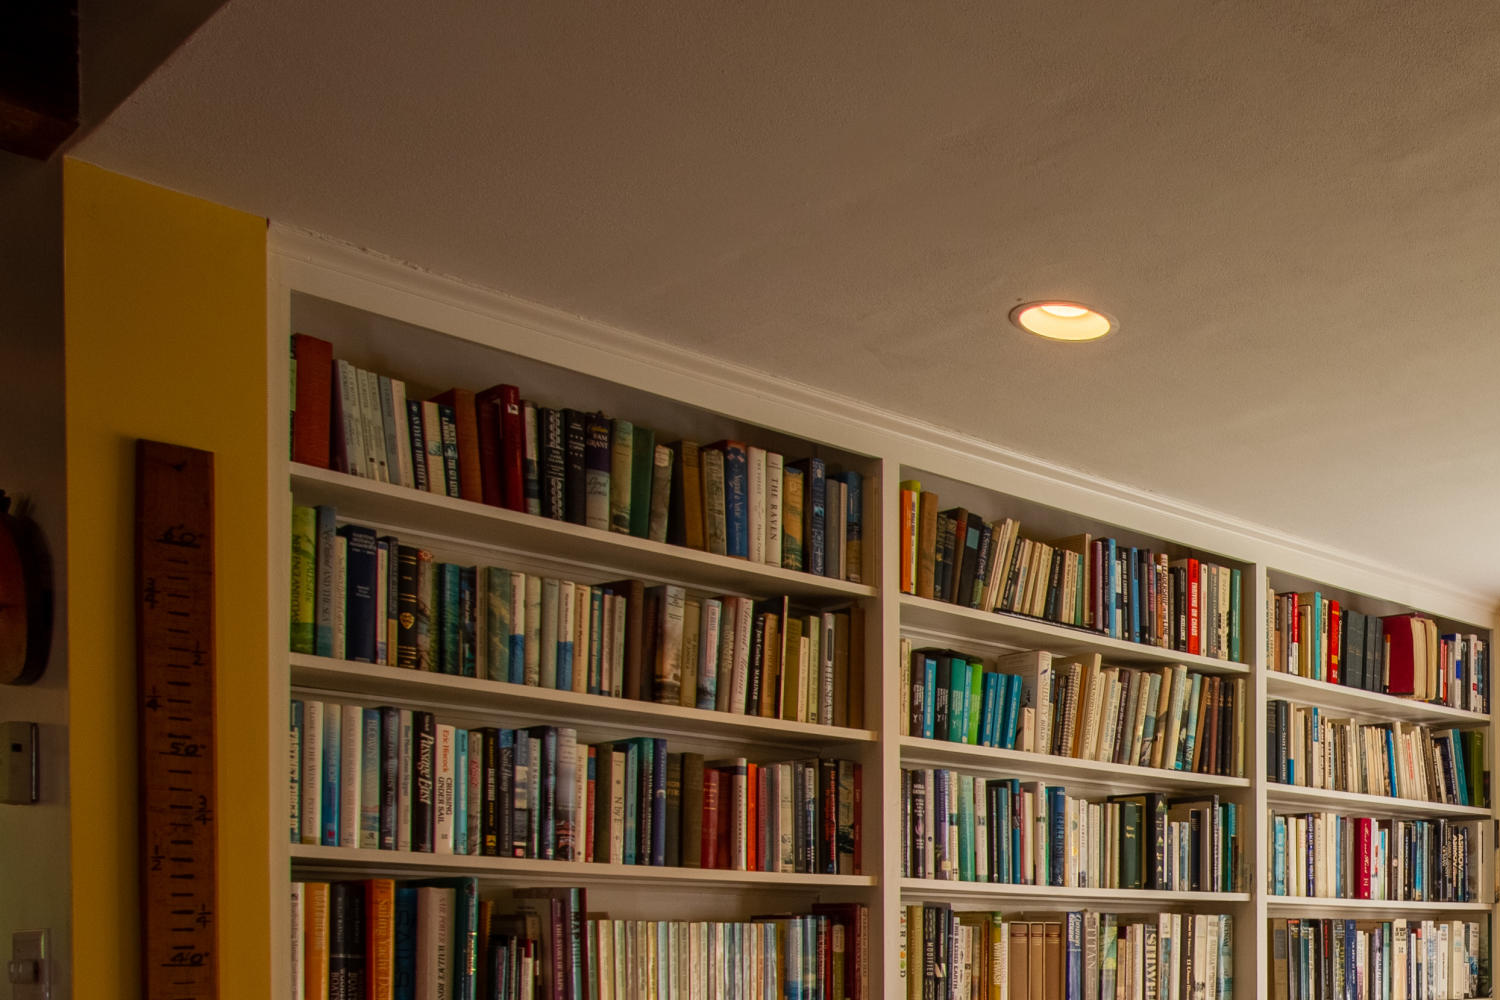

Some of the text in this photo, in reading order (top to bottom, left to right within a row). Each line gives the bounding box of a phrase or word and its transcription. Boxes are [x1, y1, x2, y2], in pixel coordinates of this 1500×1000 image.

[770, 478, 779, 541] THE RAVEN
[752, 670, 760, 700] MARINER
[367, 719, 378, 758] BLOWN
[442, 730, 450, 772] Eric Hiscock
[418, 733, 434, 805] Passage East
[437, 806, 445, 824] SAIL
[445, 777, 453, 815] CRUISING
[376, 898, 391, 936] Sailing
[952, 922, 960, 936] THIS
[376, 939, 391, 970] Yacht
[437, 944, 446, 979] WALLACE
[466, 931, 477, 976] Longitude
[926, 942, 935, 976] MODIFIED
[952, 937, 960, 964] BLESSED
[993, 942, 1001, 985] WHITEWASH
[1086, 927, 1097, 969] TITAN
